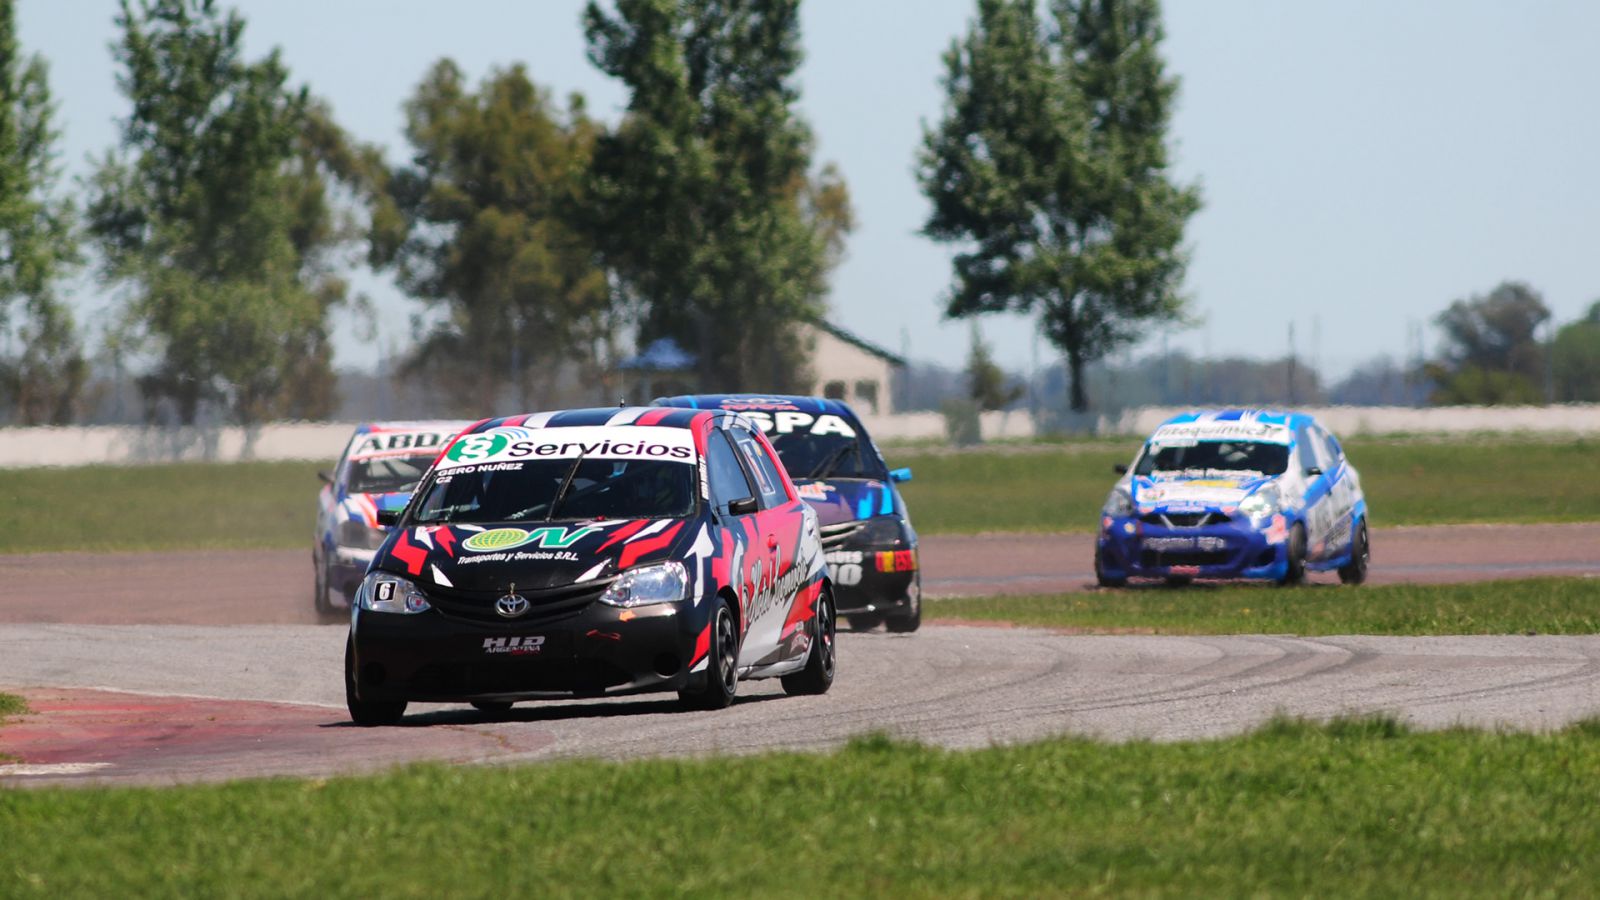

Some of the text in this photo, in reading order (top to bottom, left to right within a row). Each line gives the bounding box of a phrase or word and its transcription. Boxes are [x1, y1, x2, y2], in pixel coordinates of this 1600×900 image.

[508, 439, 692, 459] Servicios
[437, 462, 524, 477] GERO NUÑEZ
[436, 475, 453, 485] C2
[457, 552, 505, 565] Transportes
[505, 553, 513, 563] y
[514, 551, 553, 561] Servicios
[379, 582, 391, 600] 6
[482, 635, 546, 648] HID
[485, 645, 541, 654] ARGENTINA
